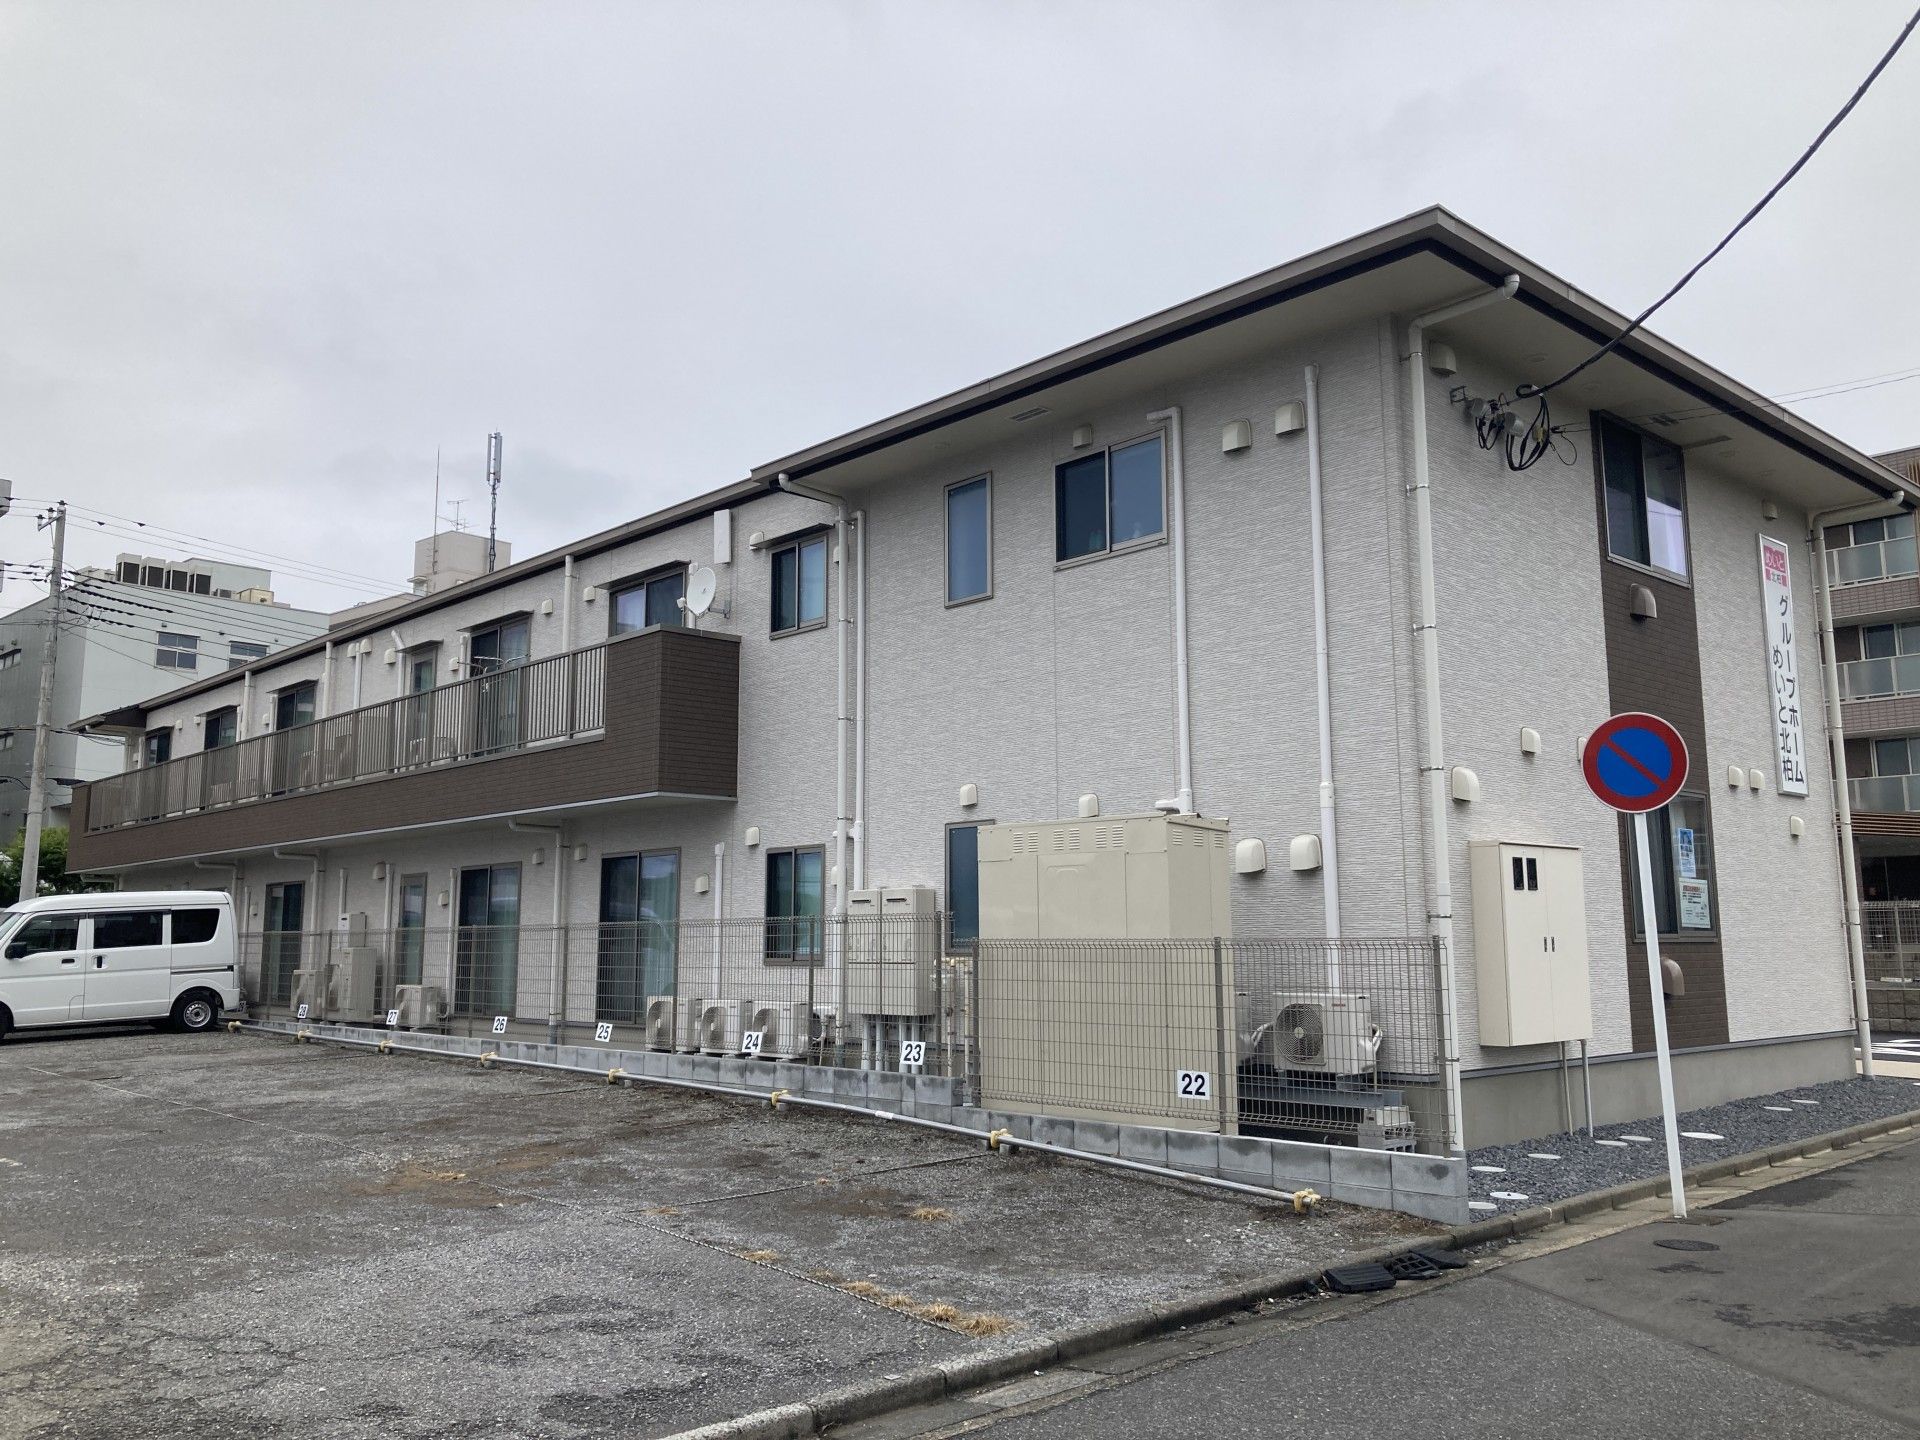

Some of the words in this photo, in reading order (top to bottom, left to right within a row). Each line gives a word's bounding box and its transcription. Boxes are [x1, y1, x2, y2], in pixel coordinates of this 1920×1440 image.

[1779, 594, 1805, 784] グループホーム
[1773, 644, 1794, 783] めいと北柏
[388, 1011, 397, 1023] 27
[494, 1018, 505, 1032] 26
[597, 1024, 610, 1040] 25
[744, 1033, 760, 1050] 24
[903, 1043, 922, 1063] 23
[1181, 1073, 1206, 1096] 22
